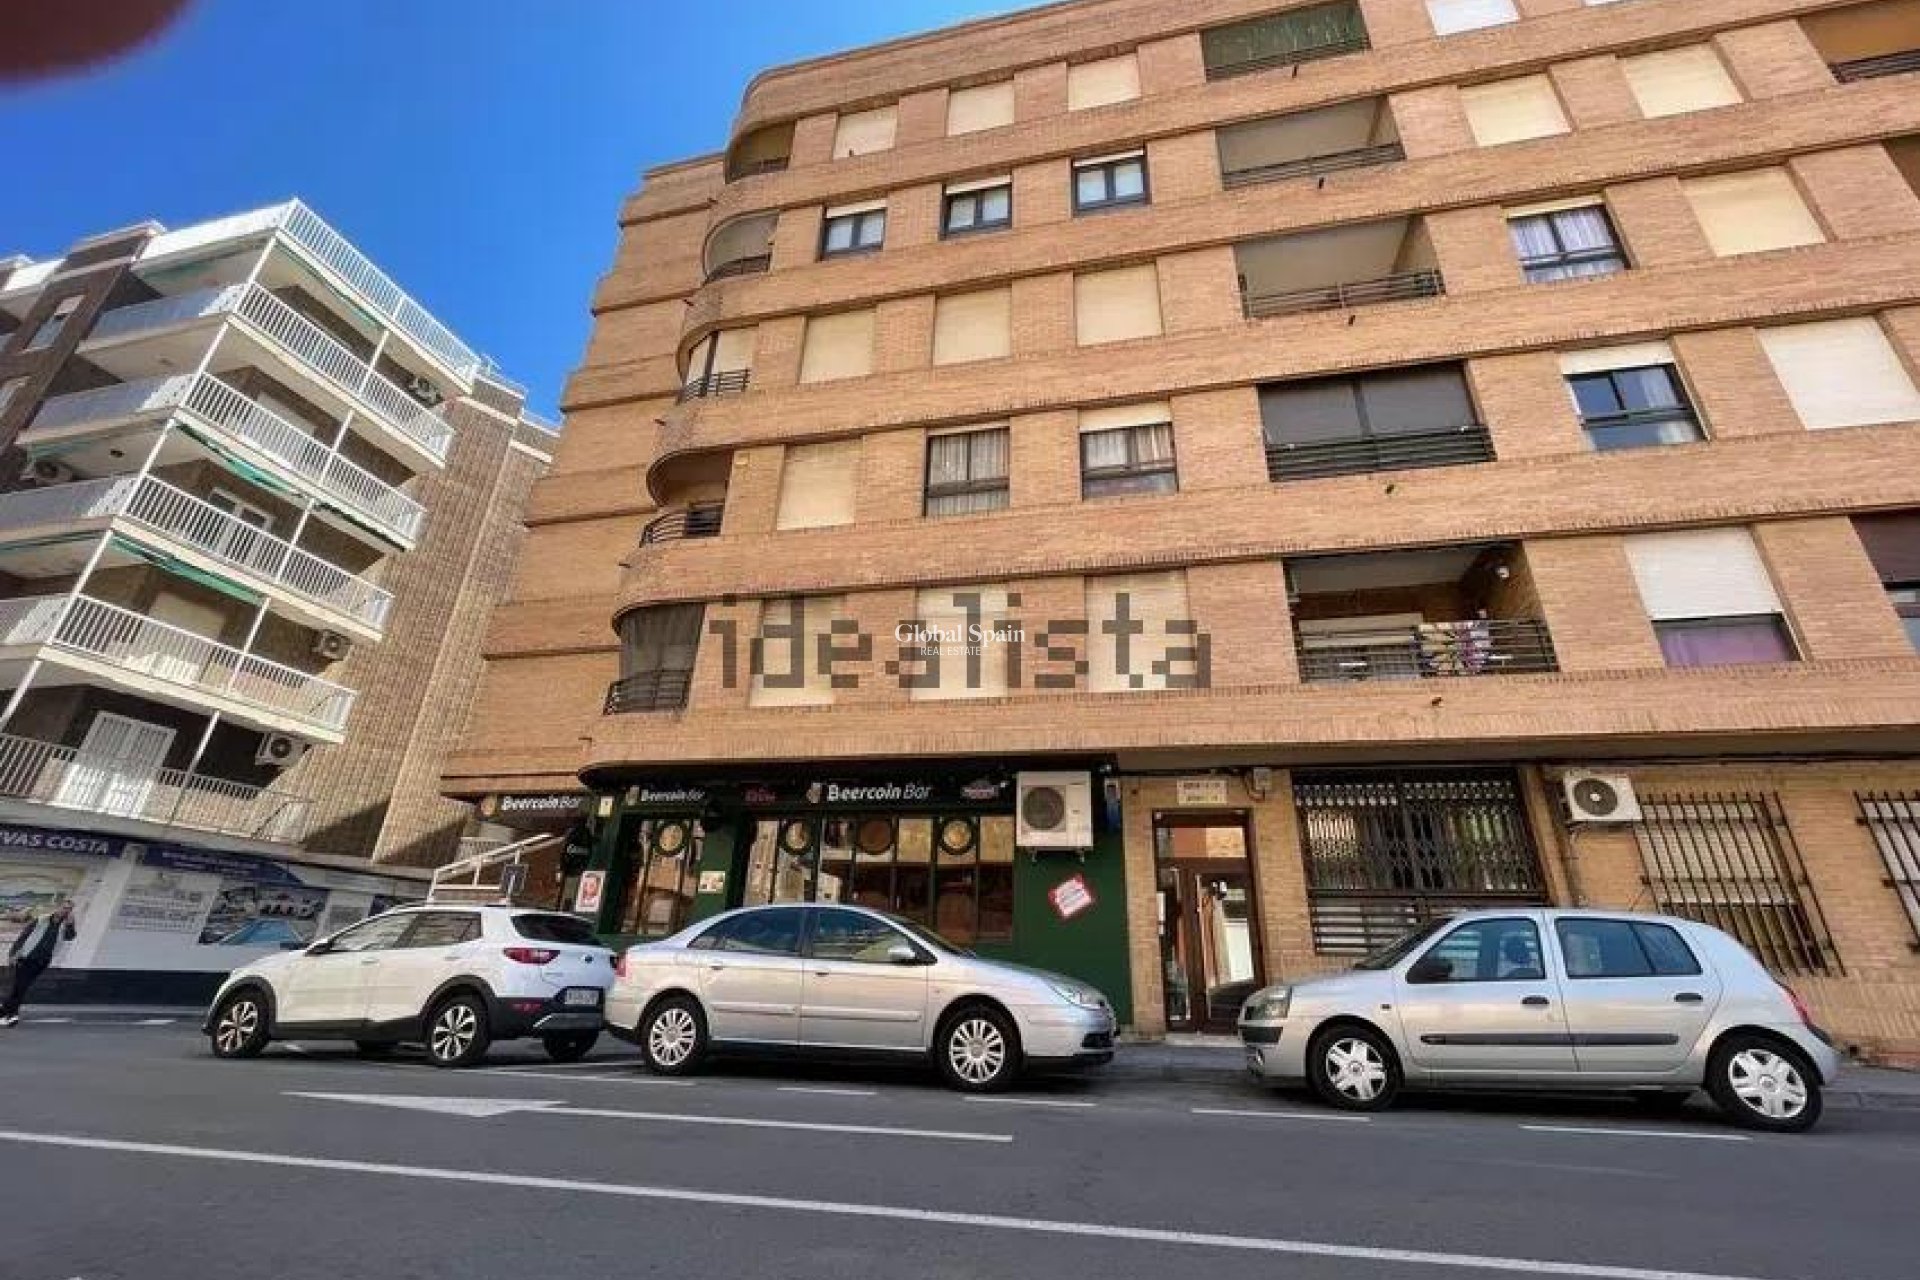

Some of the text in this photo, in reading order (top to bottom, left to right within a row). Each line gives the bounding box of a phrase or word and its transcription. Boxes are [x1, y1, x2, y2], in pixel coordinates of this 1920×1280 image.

[826, 782, 932, 801] Beercoin Bar
[501, 794, 559, 811] Beercoin
[0, 831, 108, 856] VAS COSTA
